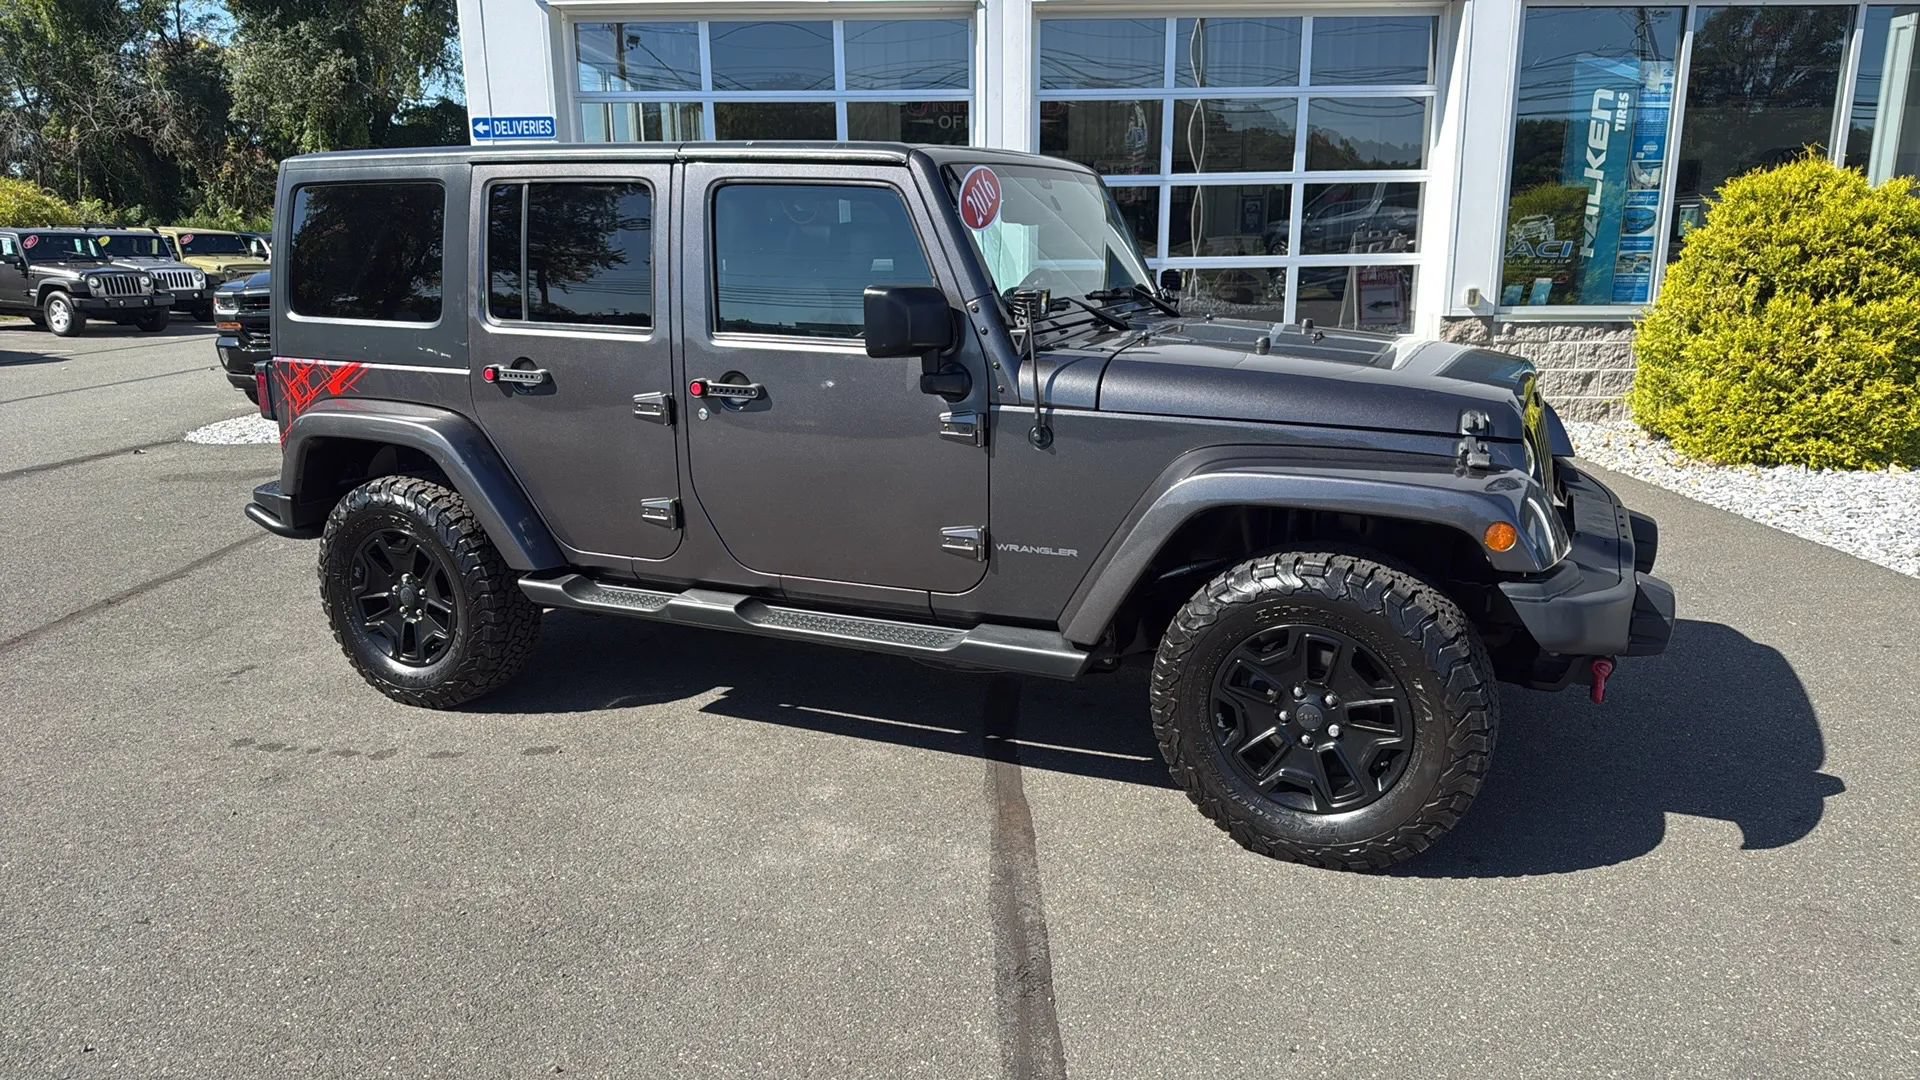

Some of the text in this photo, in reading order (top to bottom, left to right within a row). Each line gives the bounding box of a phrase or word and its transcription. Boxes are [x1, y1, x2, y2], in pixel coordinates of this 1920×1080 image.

[1615, 92, 1630, 132] TIRES
[493, 119, 552, 135] DELIVERIES
[966, 169, 996, 227] 2016
[1504, 240, 1574, 258] ACI
[995, 543, 1078, 558] WRANGLER
